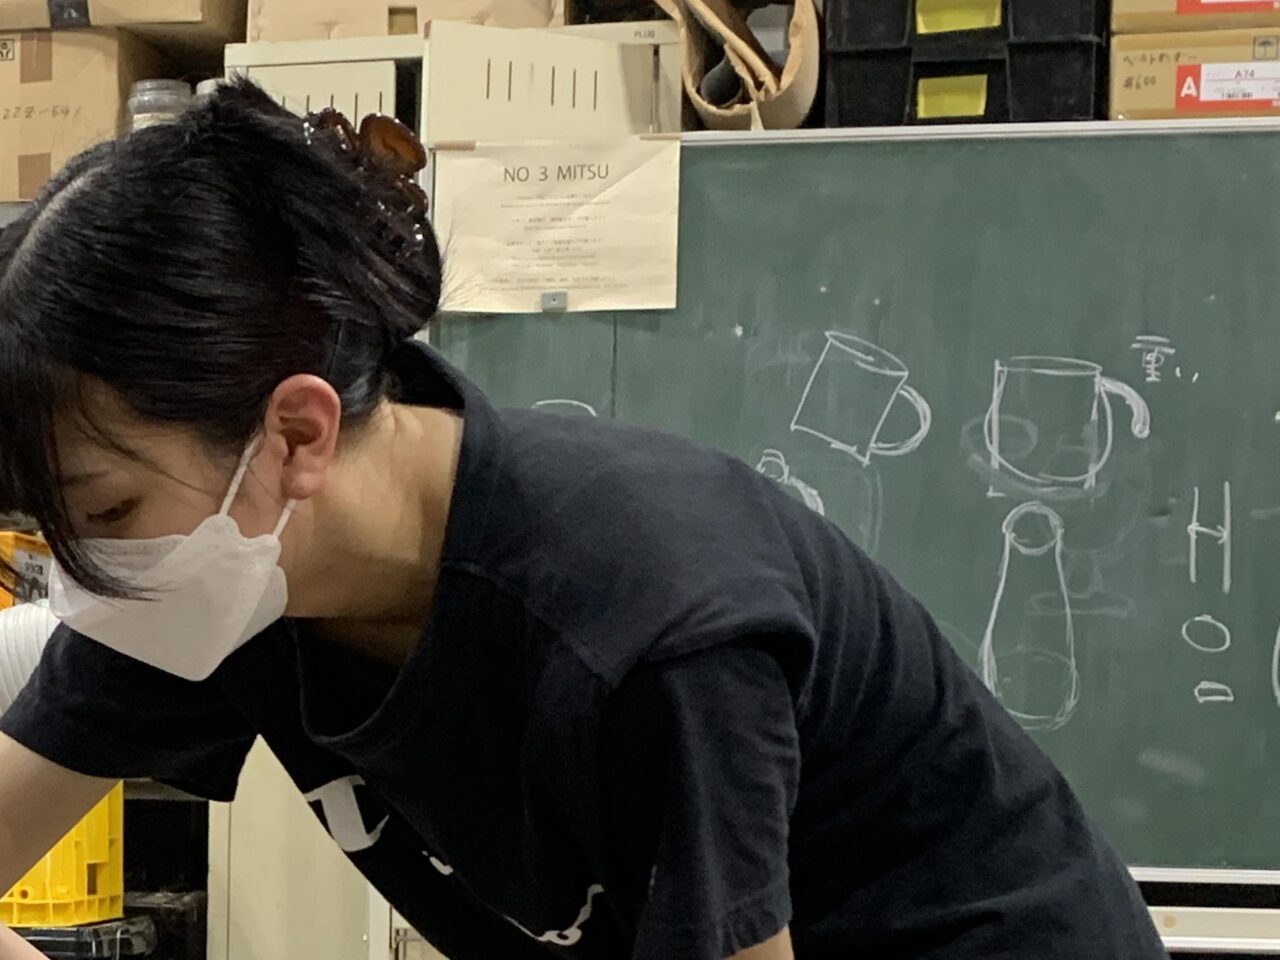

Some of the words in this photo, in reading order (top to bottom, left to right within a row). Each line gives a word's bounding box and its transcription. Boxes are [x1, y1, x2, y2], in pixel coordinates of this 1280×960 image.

[1180, 77, 1198, 97] A
[503, 166, 530, 182] NO
[538, 165, 549, 182] 3
[556, 164, 609, 180] MITSU
